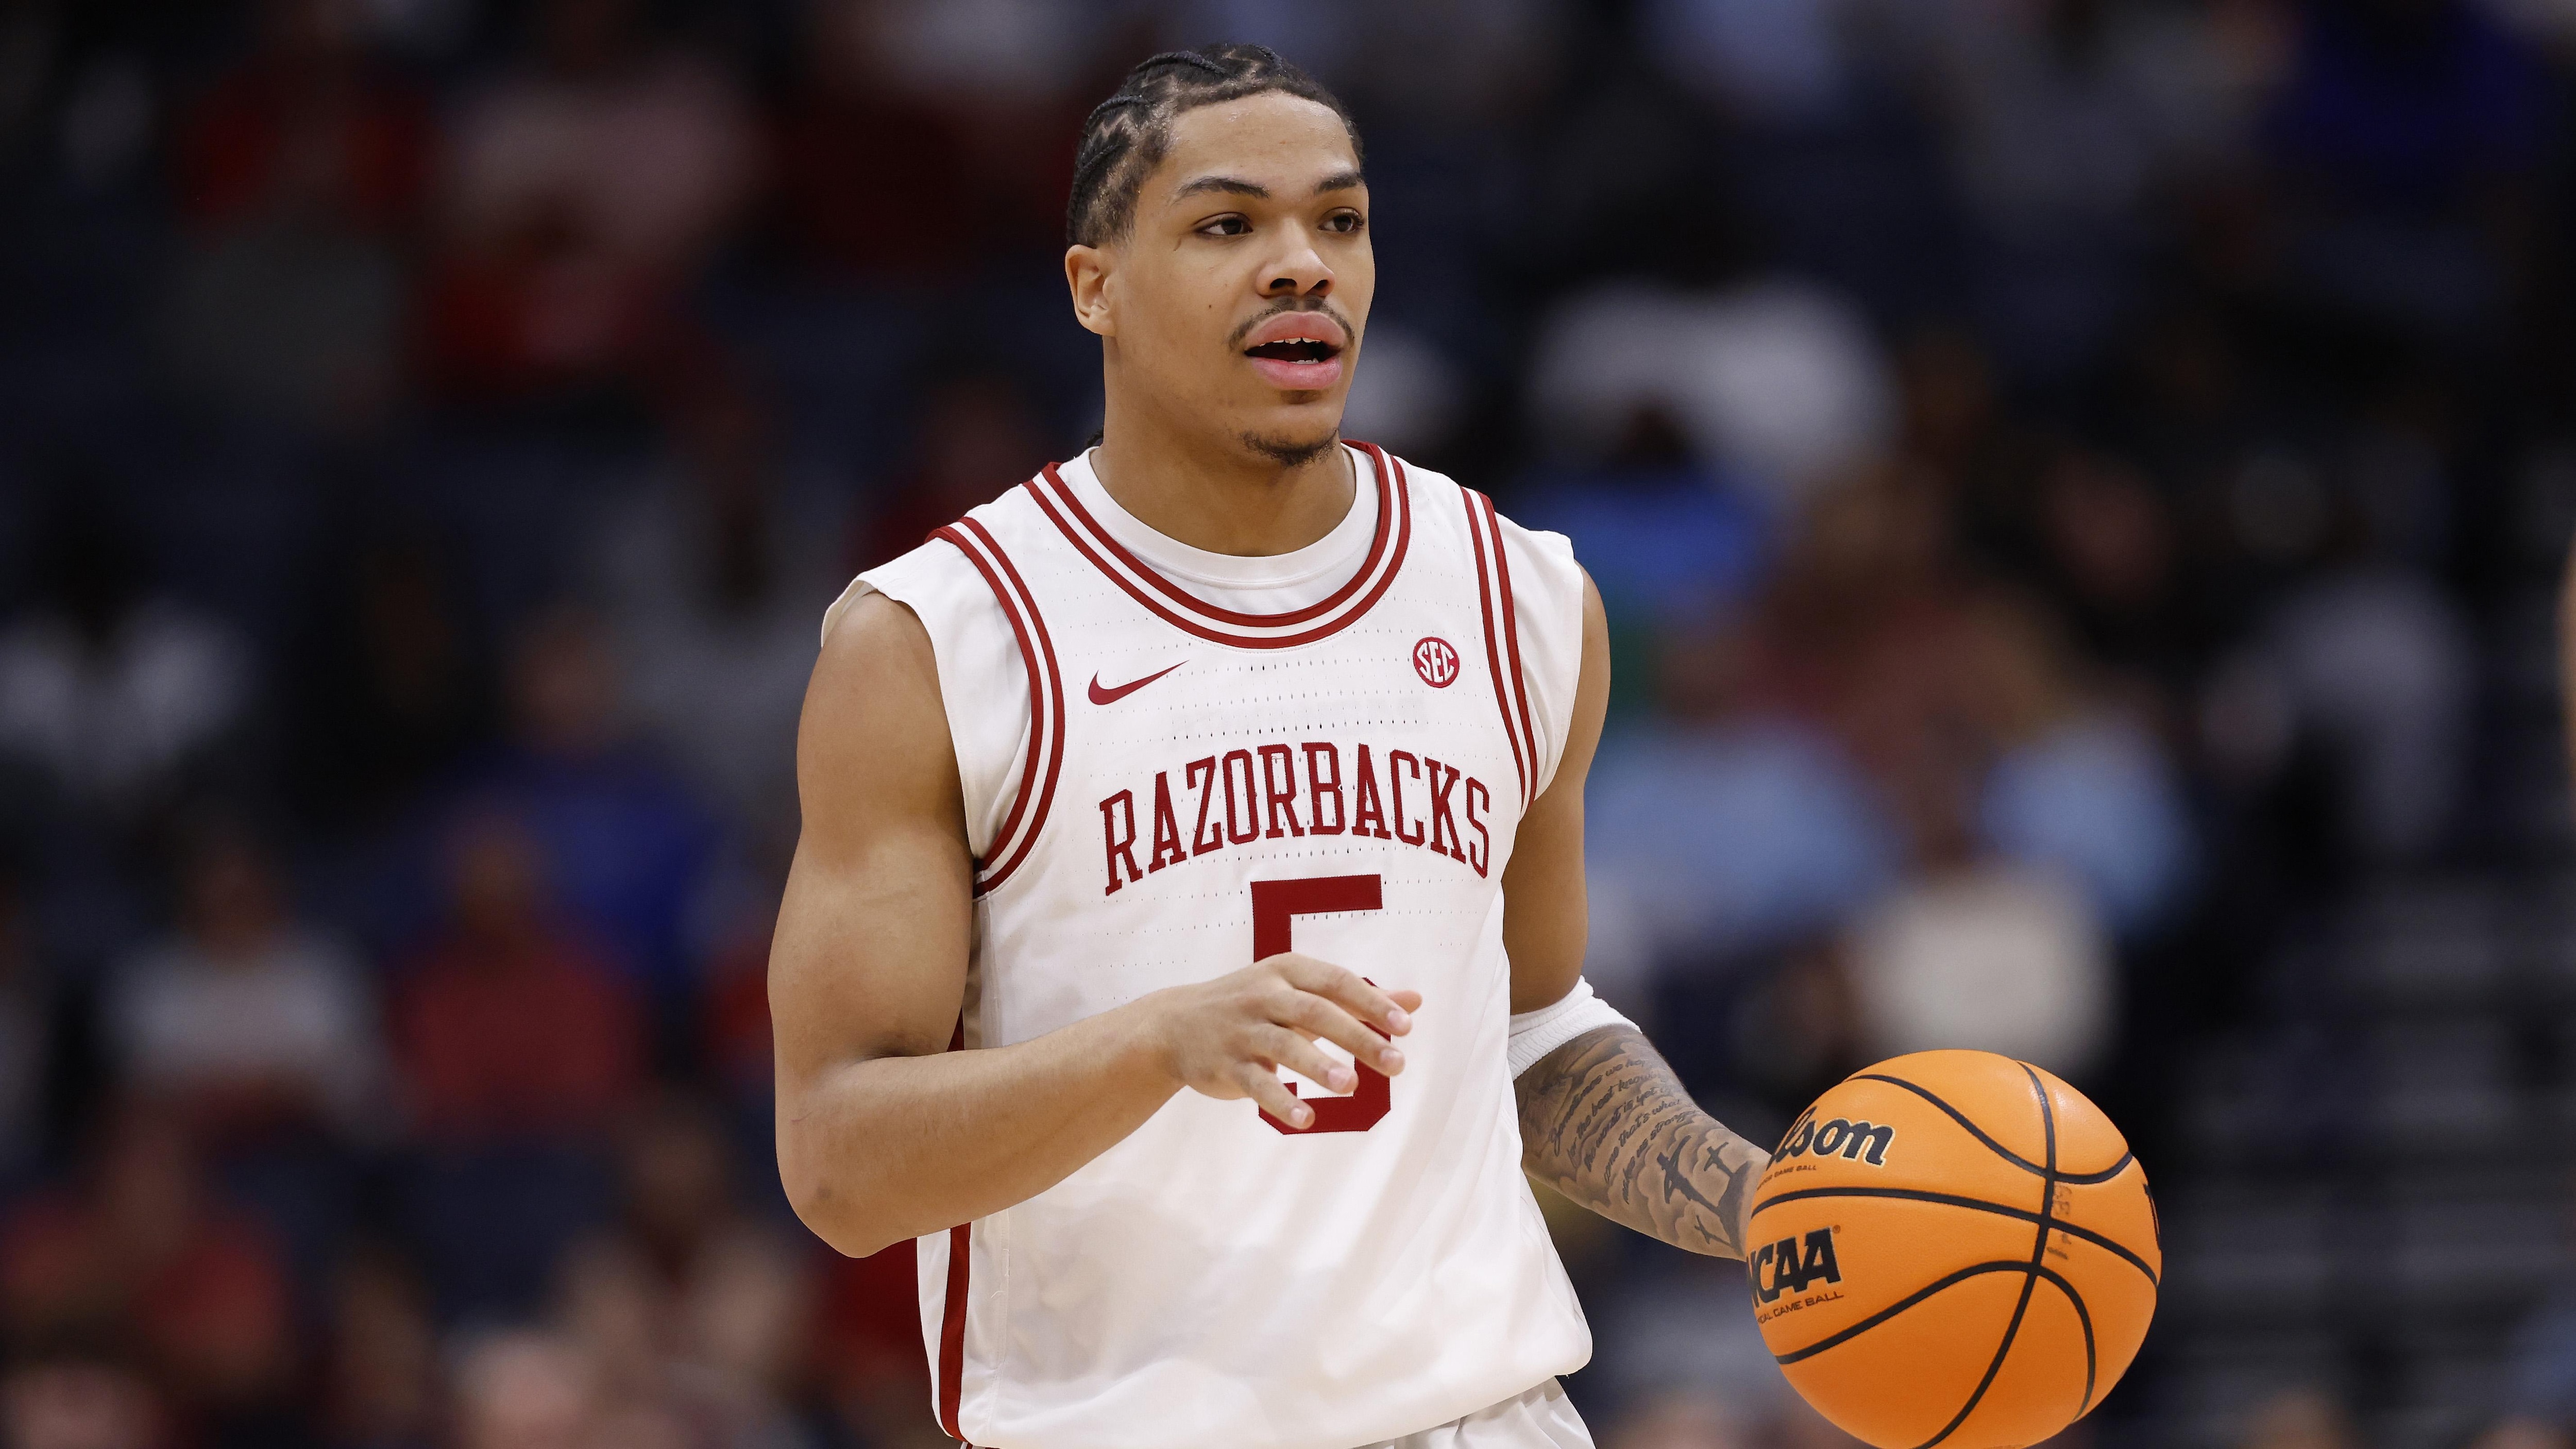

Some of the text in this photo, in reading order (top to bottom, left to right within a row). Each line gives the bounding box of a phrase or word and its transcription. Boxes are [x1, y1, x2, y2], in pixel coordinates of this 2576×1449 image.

[1416, 641, 1455, 683] SEC
[1099, 742, 1489, 897] RAZORBACKS
[1250, 874, 1391, 1135] 5
[1766, 1105, 1896, 1168] lson
[1746, 1226, 1841, 1308] NCAA
[1773, 1301, 1803, 1317] GAME
[1805, 1291, 1844, 1307] BALL
